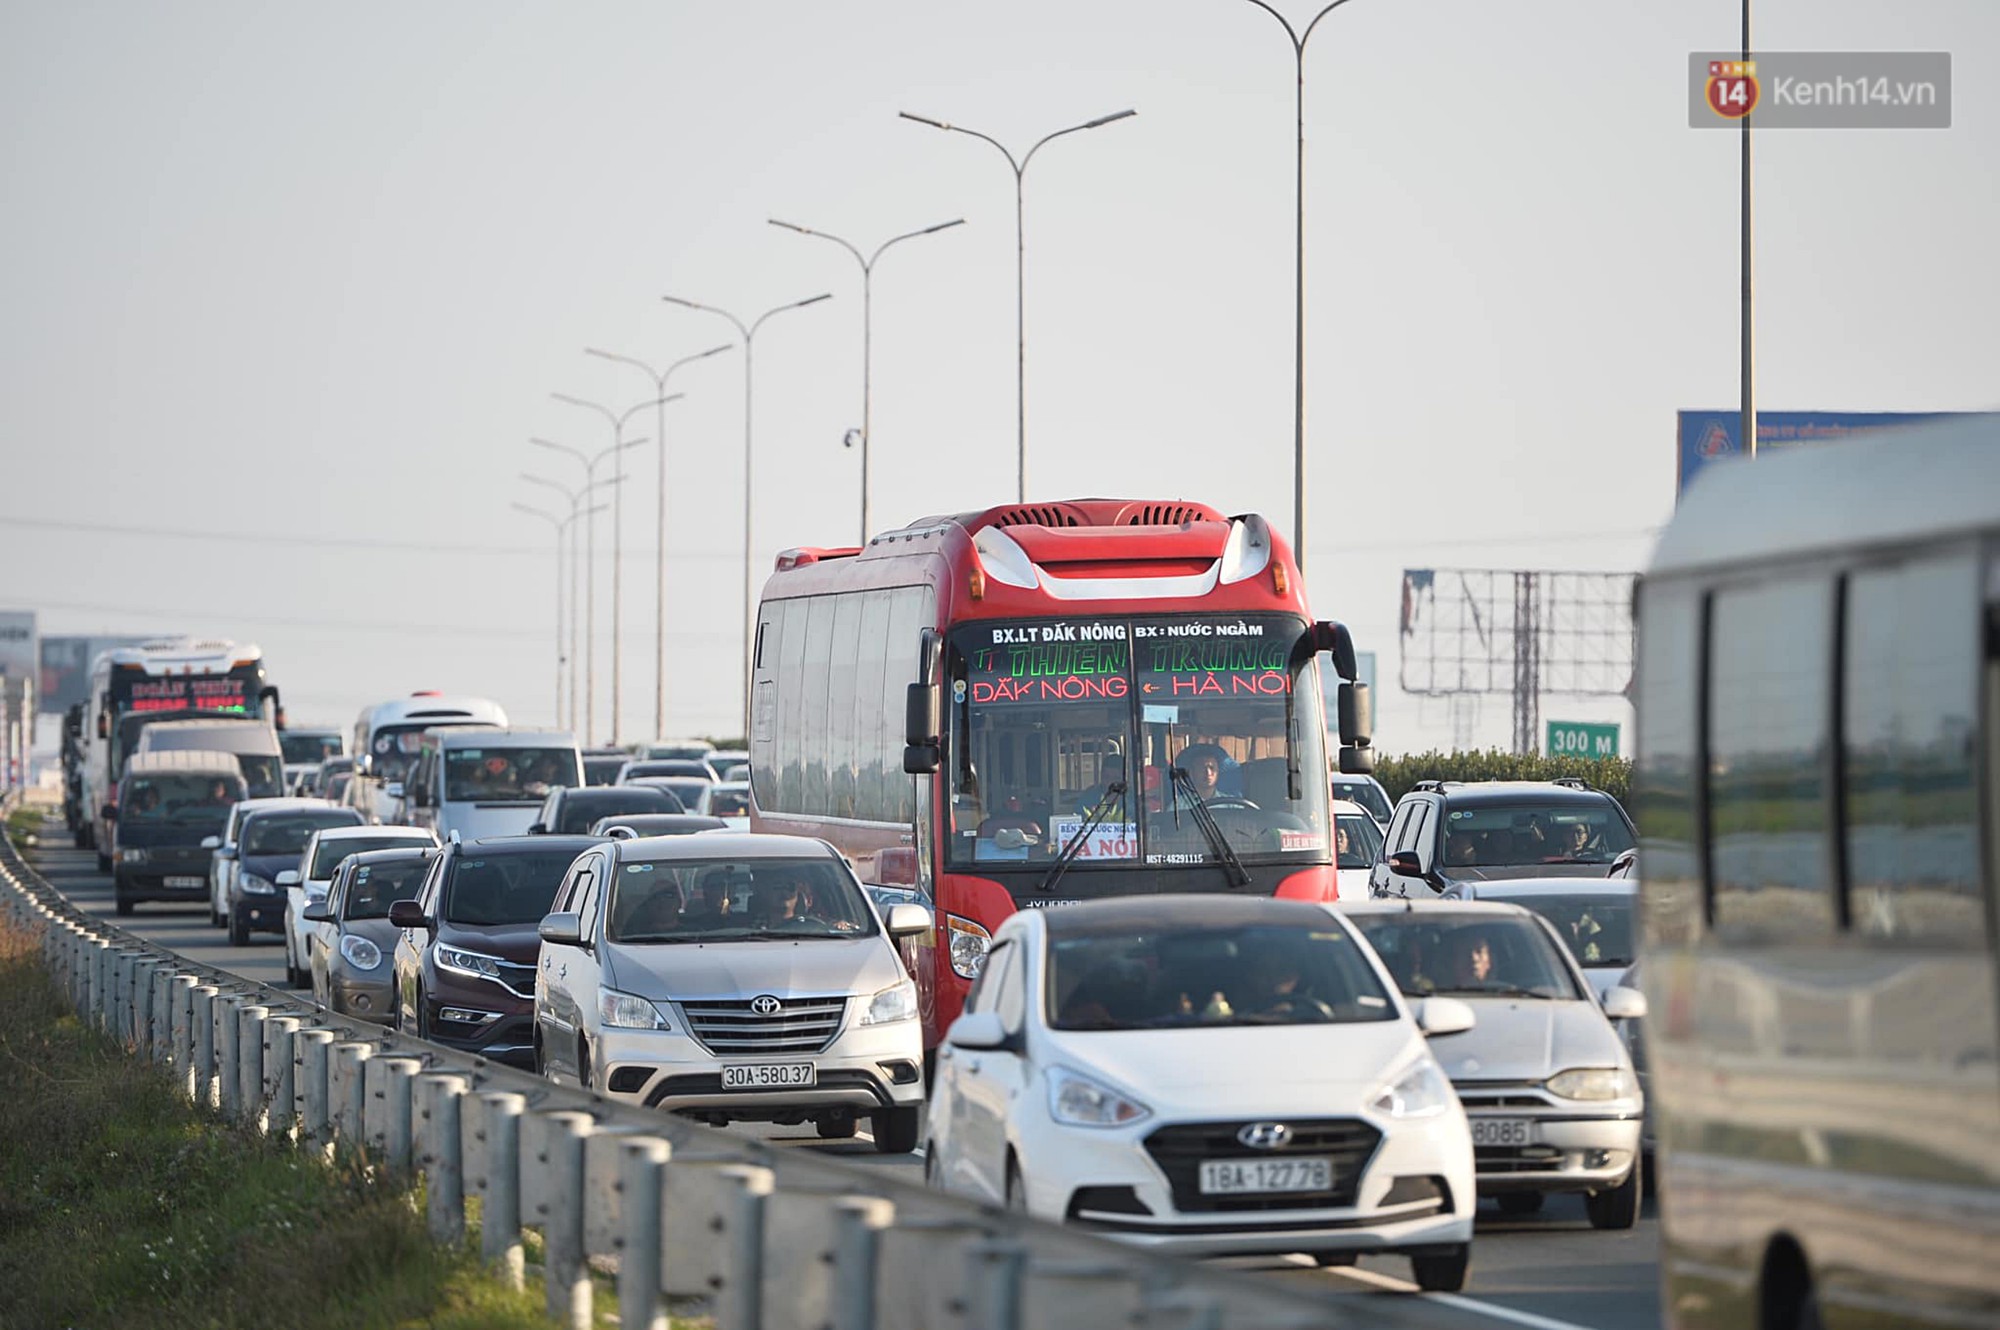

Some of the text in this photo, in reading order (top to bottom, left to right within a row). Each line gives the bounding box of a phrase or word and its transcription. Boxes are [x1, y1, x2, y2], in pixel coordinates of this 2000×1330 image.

[992, 622, 1126, 644] BX.LT ĐẮK NÔNG
[1167, 621, 1213, 637] NƯỚC
[1216, 620, 1264, 636] NGẦM
[973, 670, 1291, 702] ĐẮK NÔNG HÀ NỘI
[1554, 729, 1612, 754] 300 M
